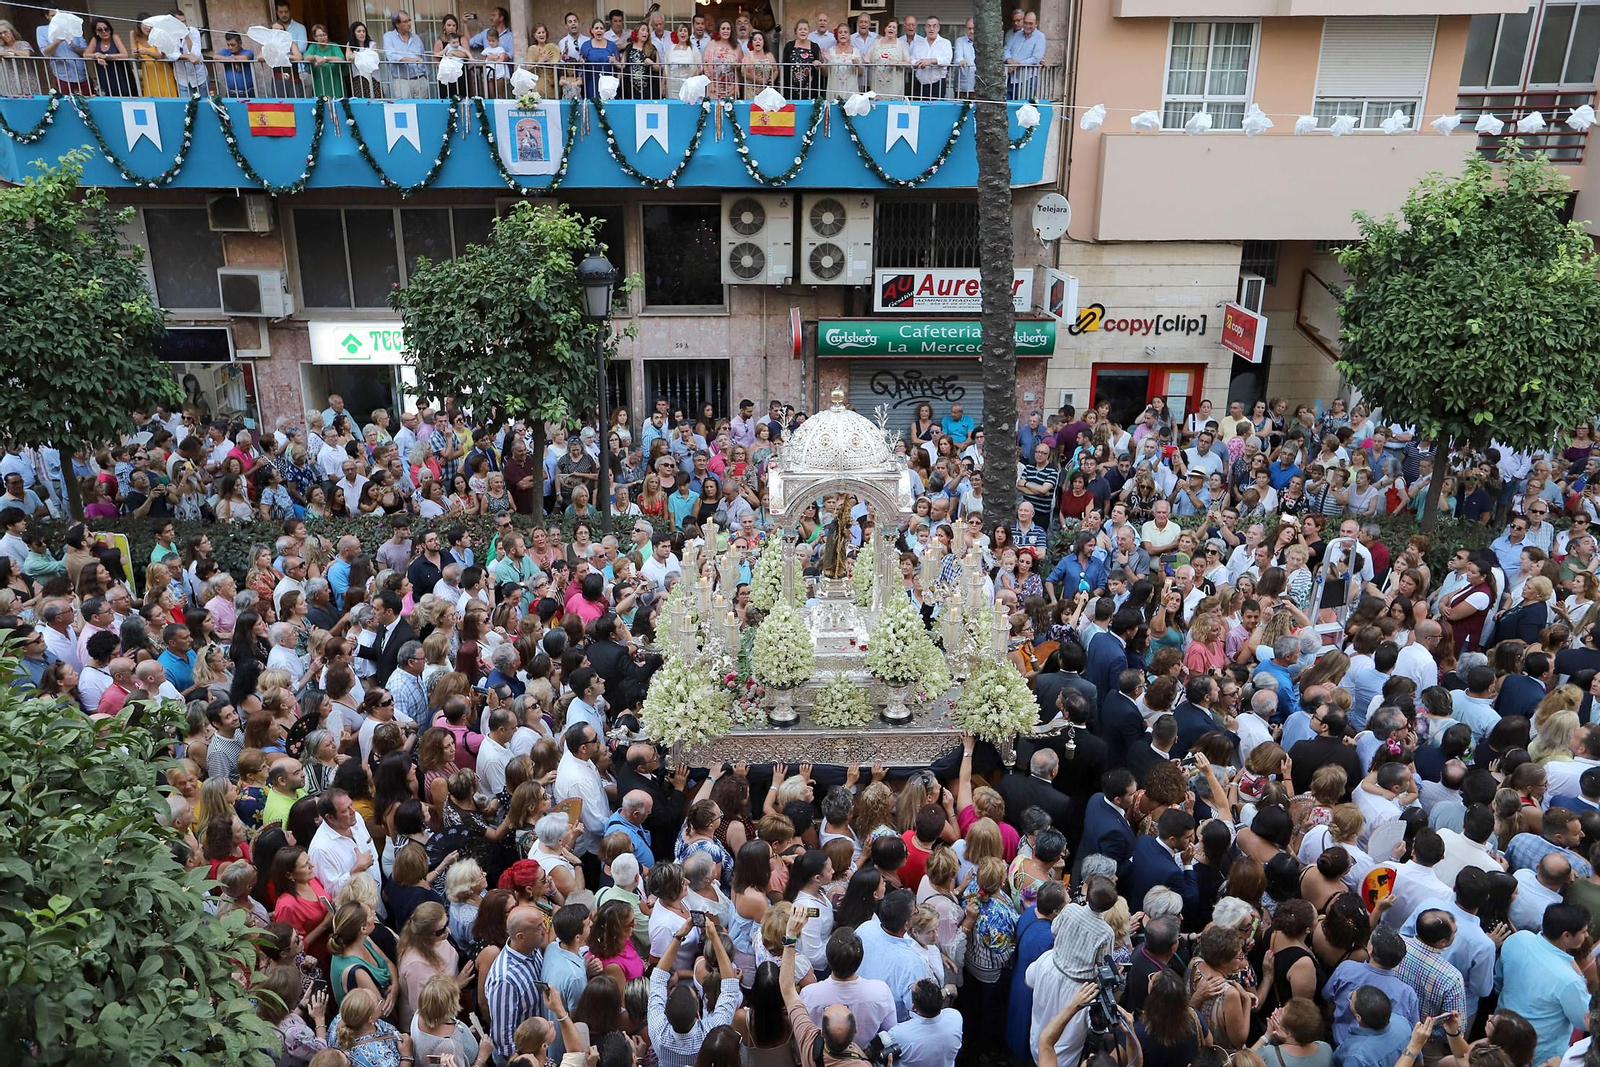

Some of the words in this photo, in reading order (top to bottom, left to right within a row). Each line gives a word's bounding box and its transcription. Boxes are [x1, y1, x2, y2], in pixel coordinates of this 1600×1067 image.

[1037, 204, 1067, 213] Telejara
[899, 324, 982, 338] Cafeteria
[1231, 323, 1245, 338] copy
[826, 328, 877, 348] Carlsberg
[887, 341, 908, 353] La
